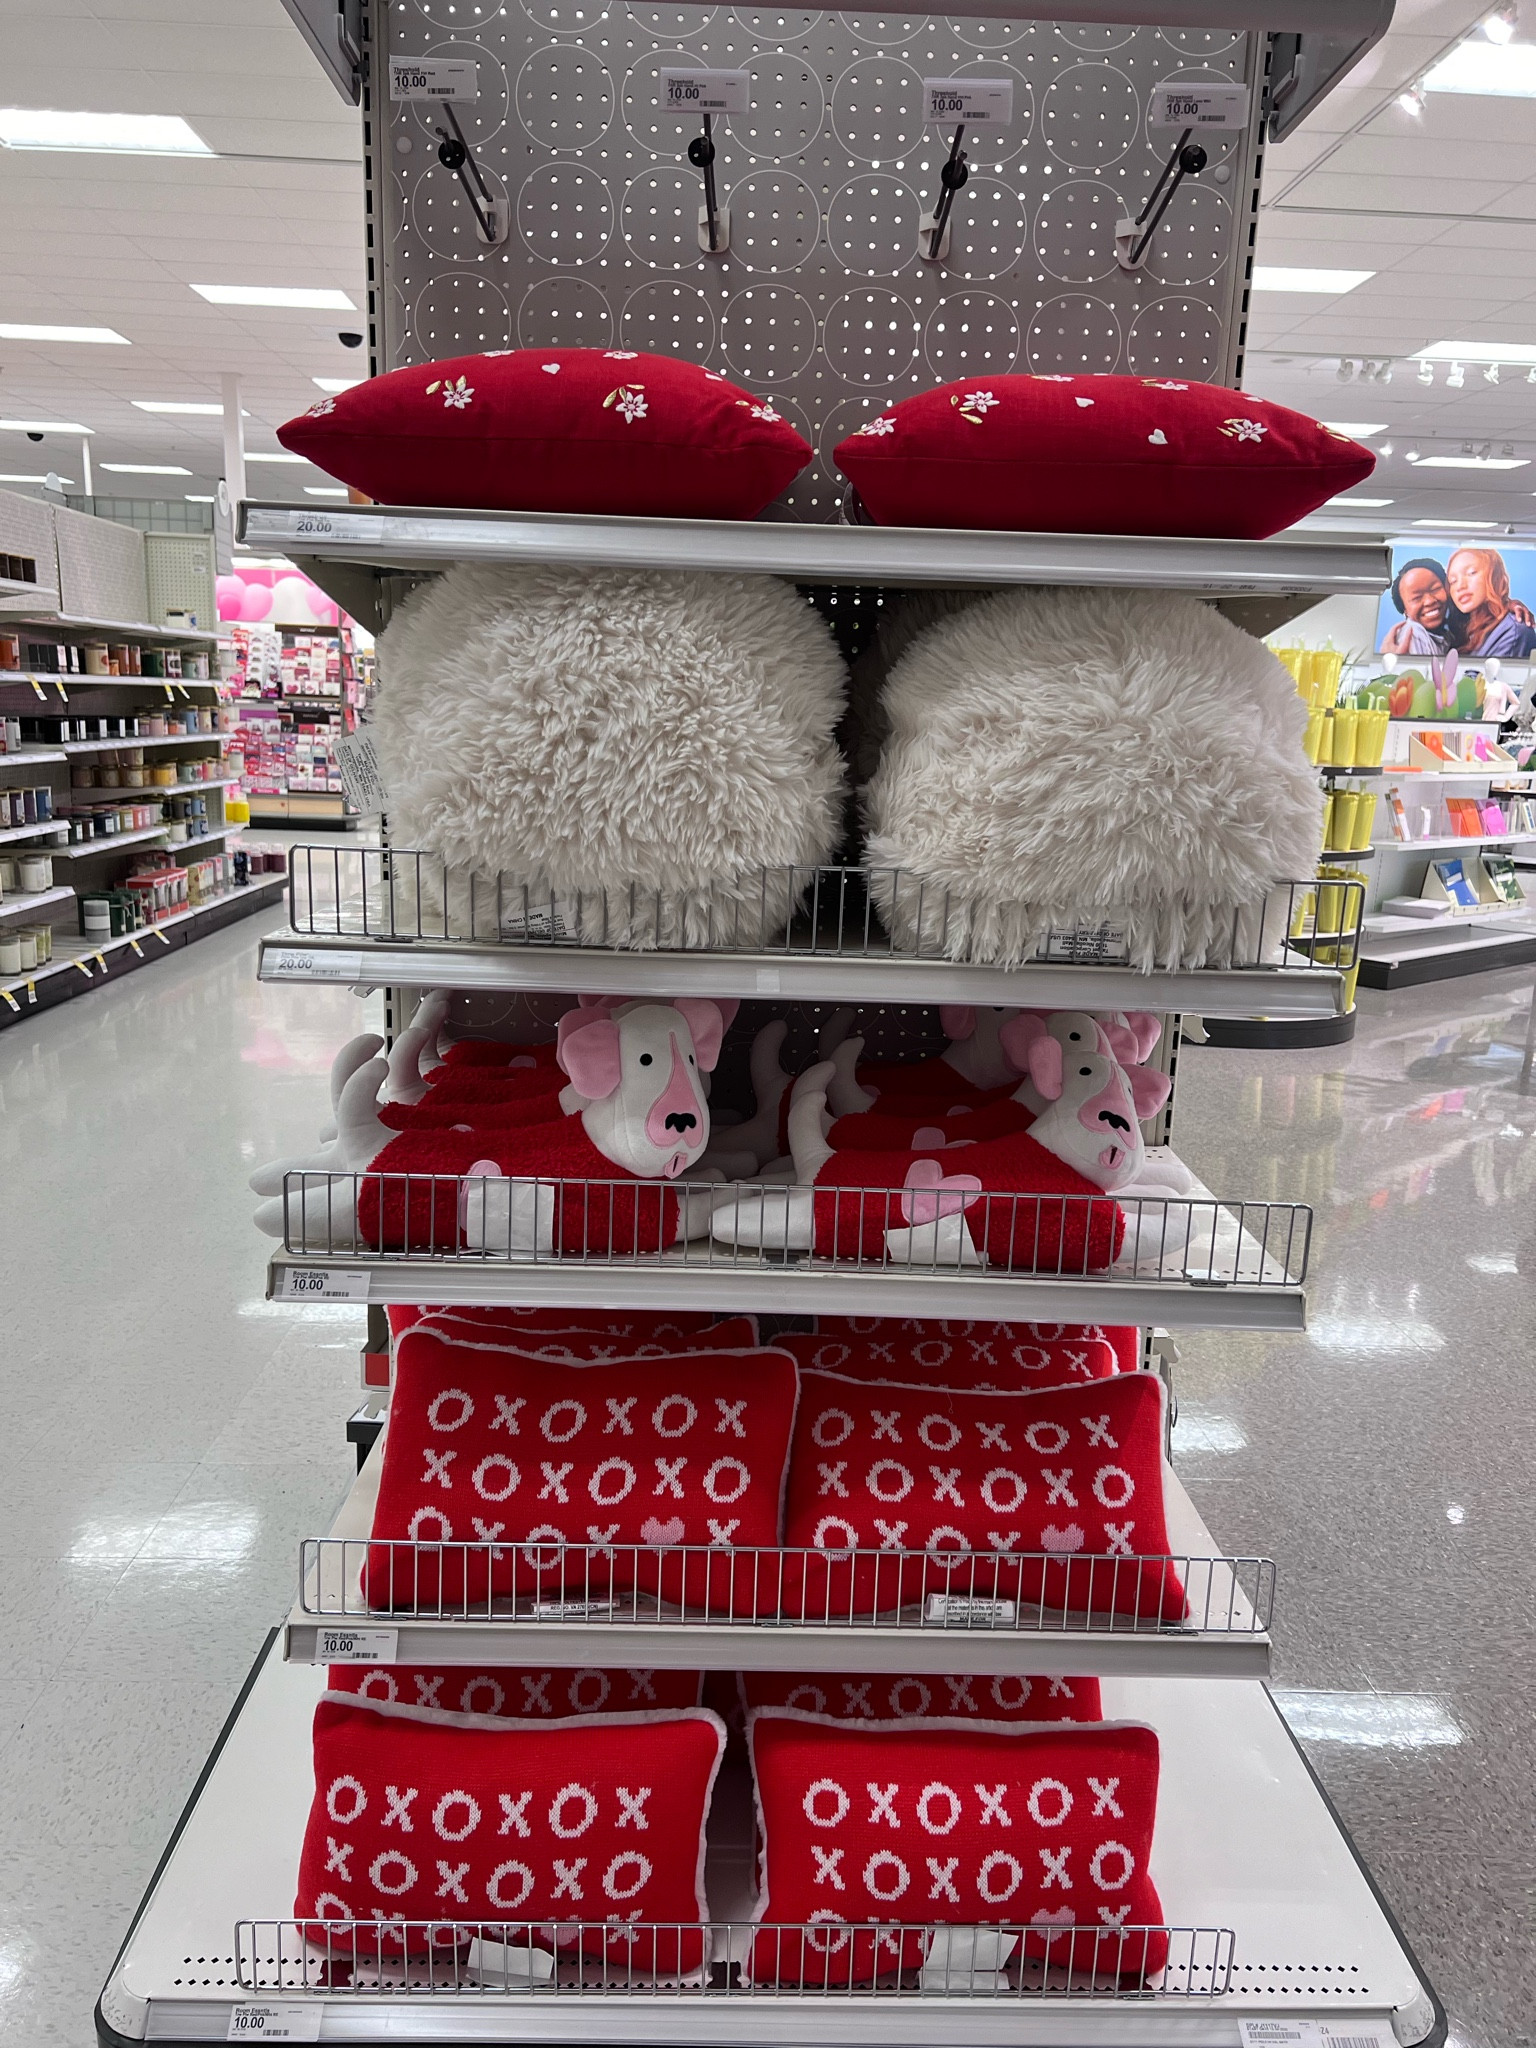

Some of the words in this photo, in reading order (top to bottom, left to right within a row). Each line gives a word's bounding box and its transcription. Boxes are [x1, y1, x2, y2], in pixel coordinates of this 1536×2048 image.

[394, 75, 427, 87] 10.00
[668, 87, 699, 99] 10.00
[931, 99, 963, 111] 10.00
[1166, 103, 1198, 114] 10.00
[296, 521, 332, 532] 20.00
[279, 959, 313, 969] 20.00
[292, 1279, 324, 1290] 10.00
[323, 1640, 353, 1651] 10.00
[234, 2016, 265, 2029] 10.00
